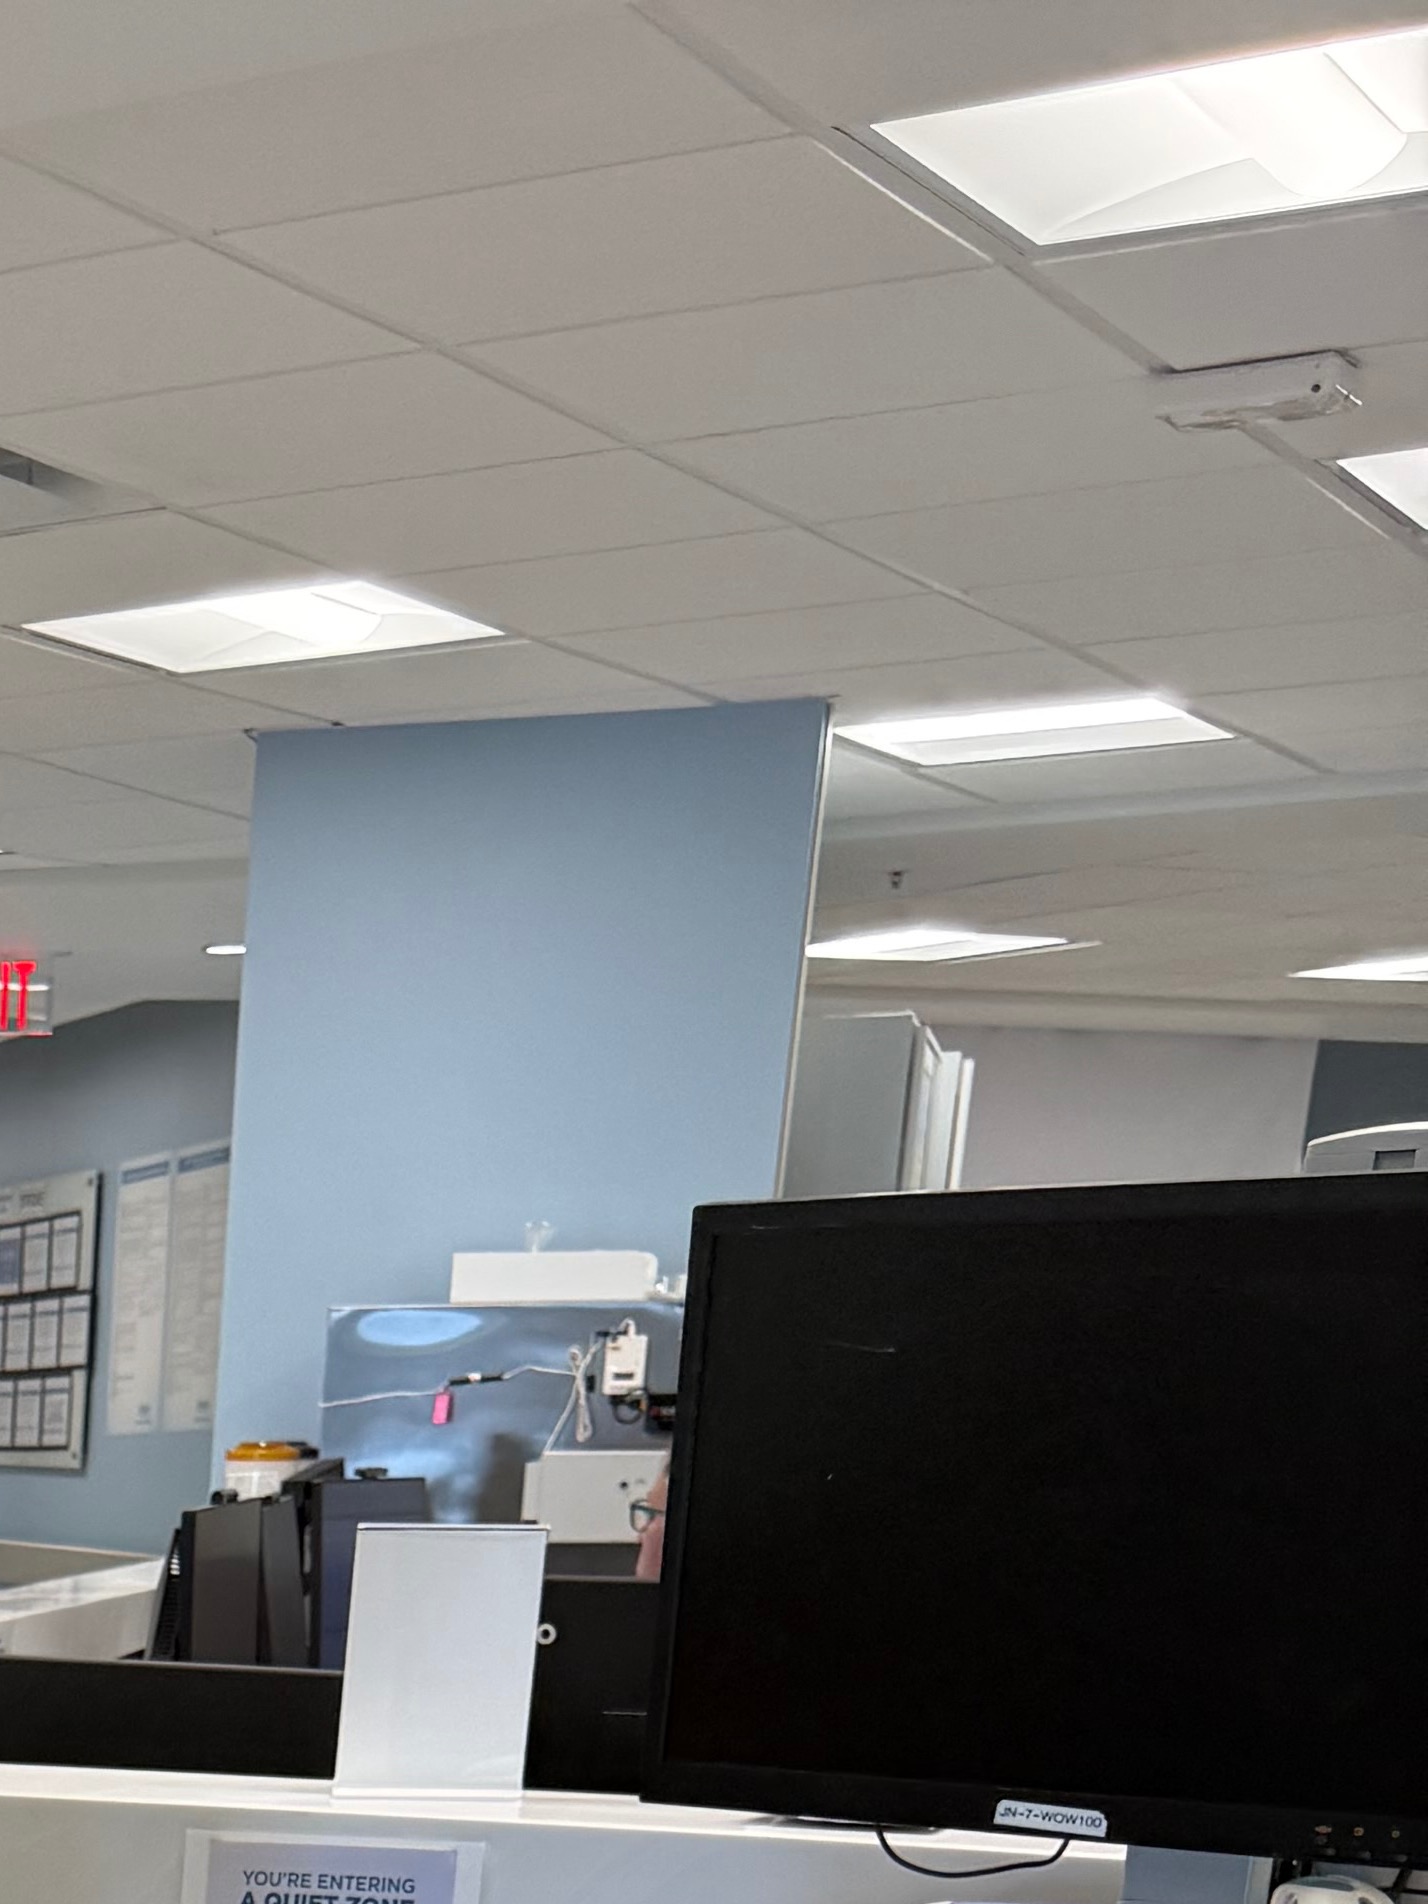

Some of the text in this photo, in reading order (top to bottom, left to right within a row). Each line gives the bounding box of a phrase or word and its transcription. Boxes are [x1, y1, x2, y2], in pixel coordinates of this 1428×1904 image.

[999, 1807, 1102, 1829] JN-7-WOW100
[243, 1870, 415, 1894] YOU'RE ENTERING
